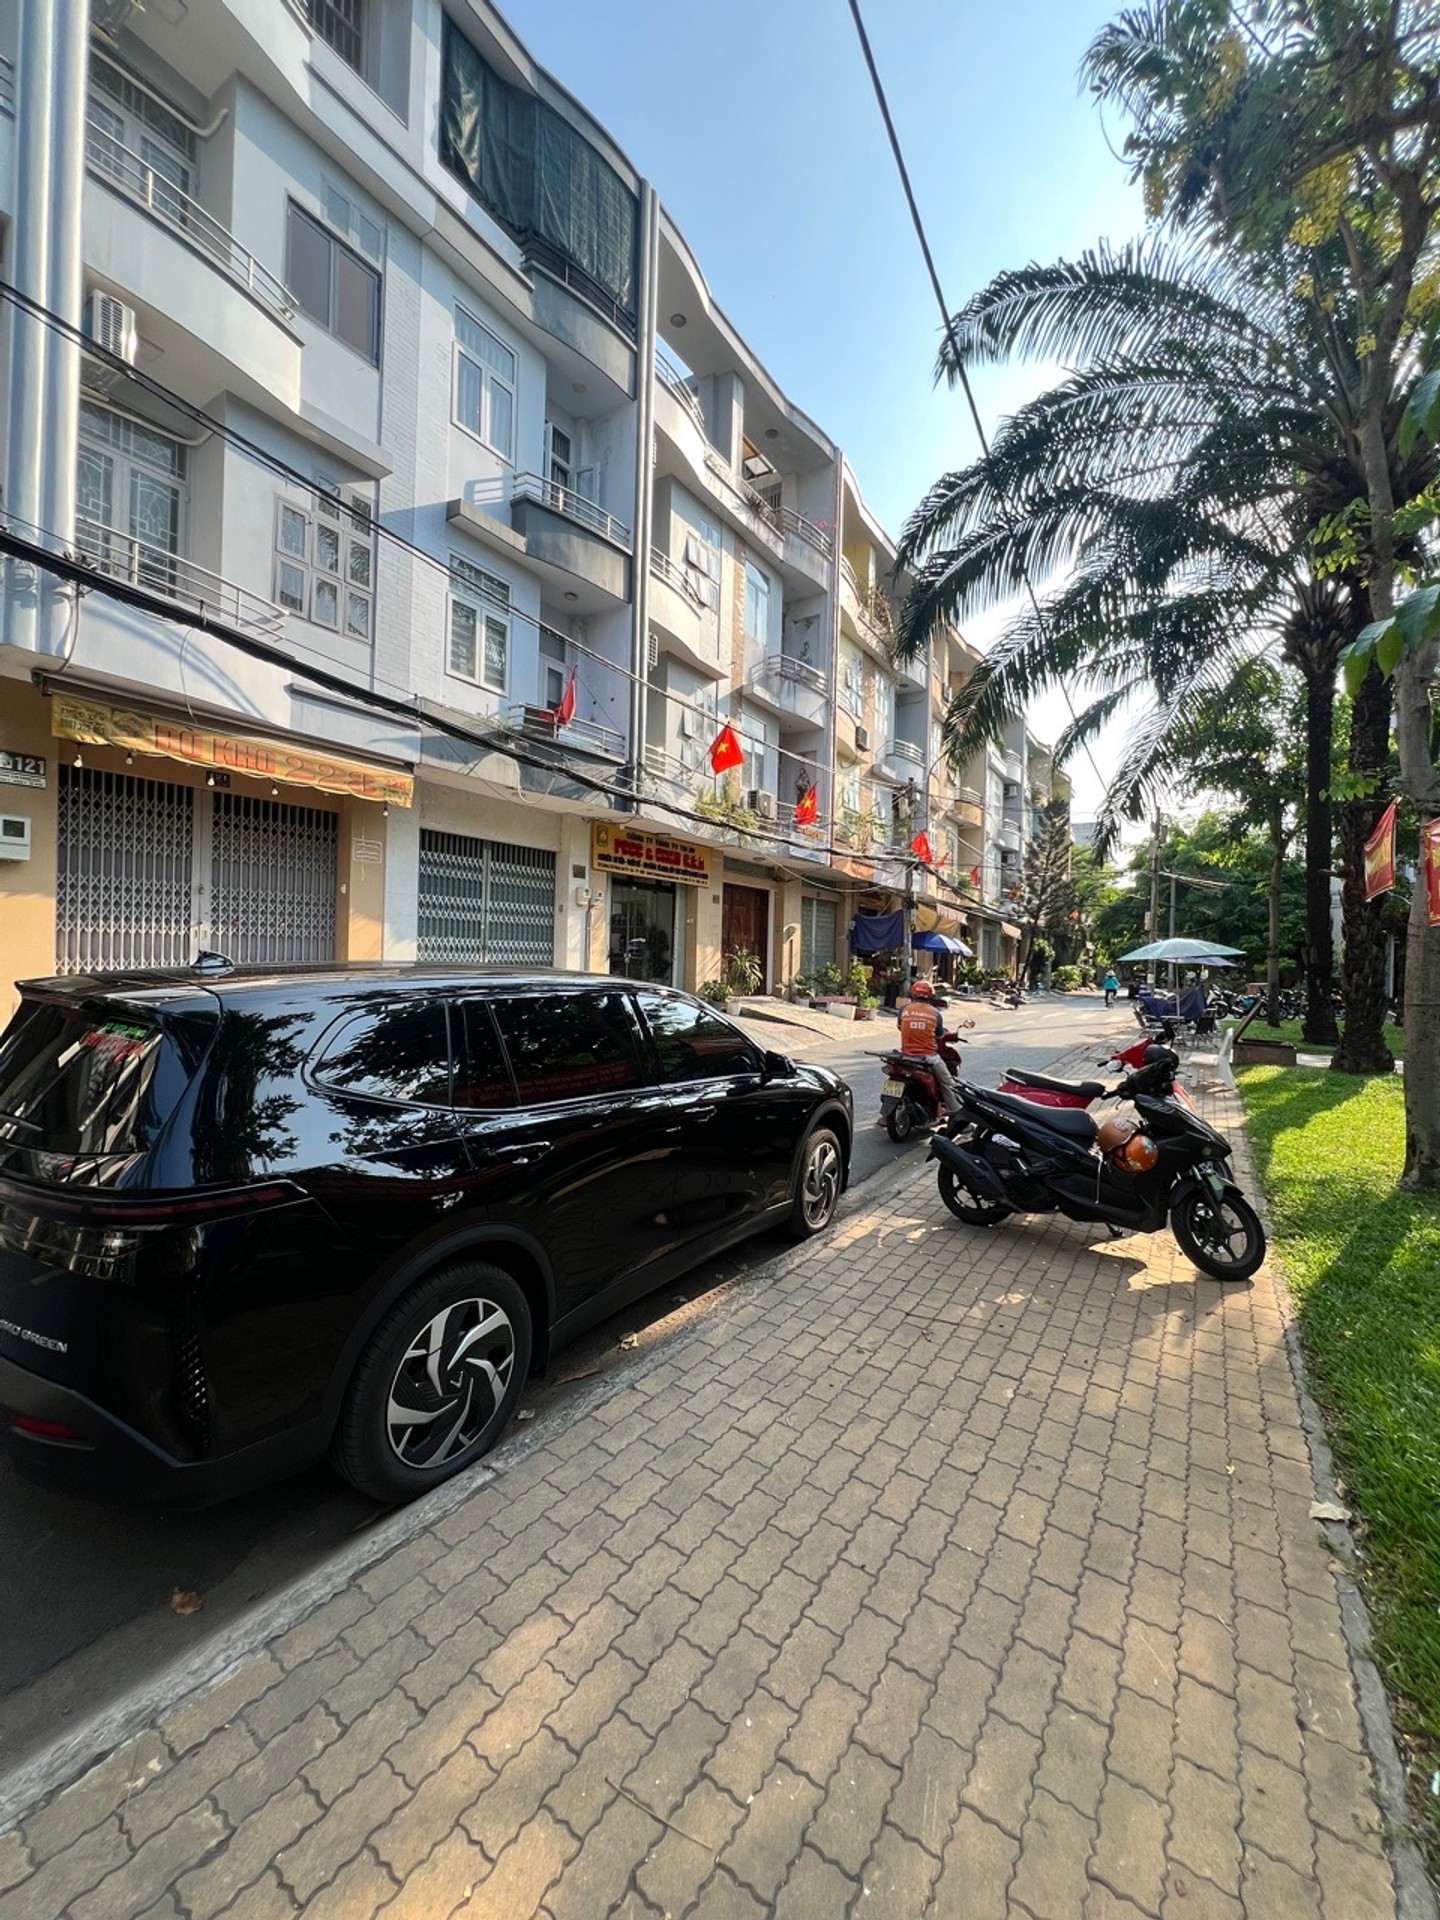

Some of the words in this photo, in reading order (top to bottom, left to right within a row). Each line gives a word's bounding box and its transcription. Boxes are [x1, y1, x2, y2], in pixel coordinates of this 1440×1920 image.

[15, 756, 45, 775] 121
[212, 738, 276, 773] KHO
[21, 1329, 68, 1354] GREEN
